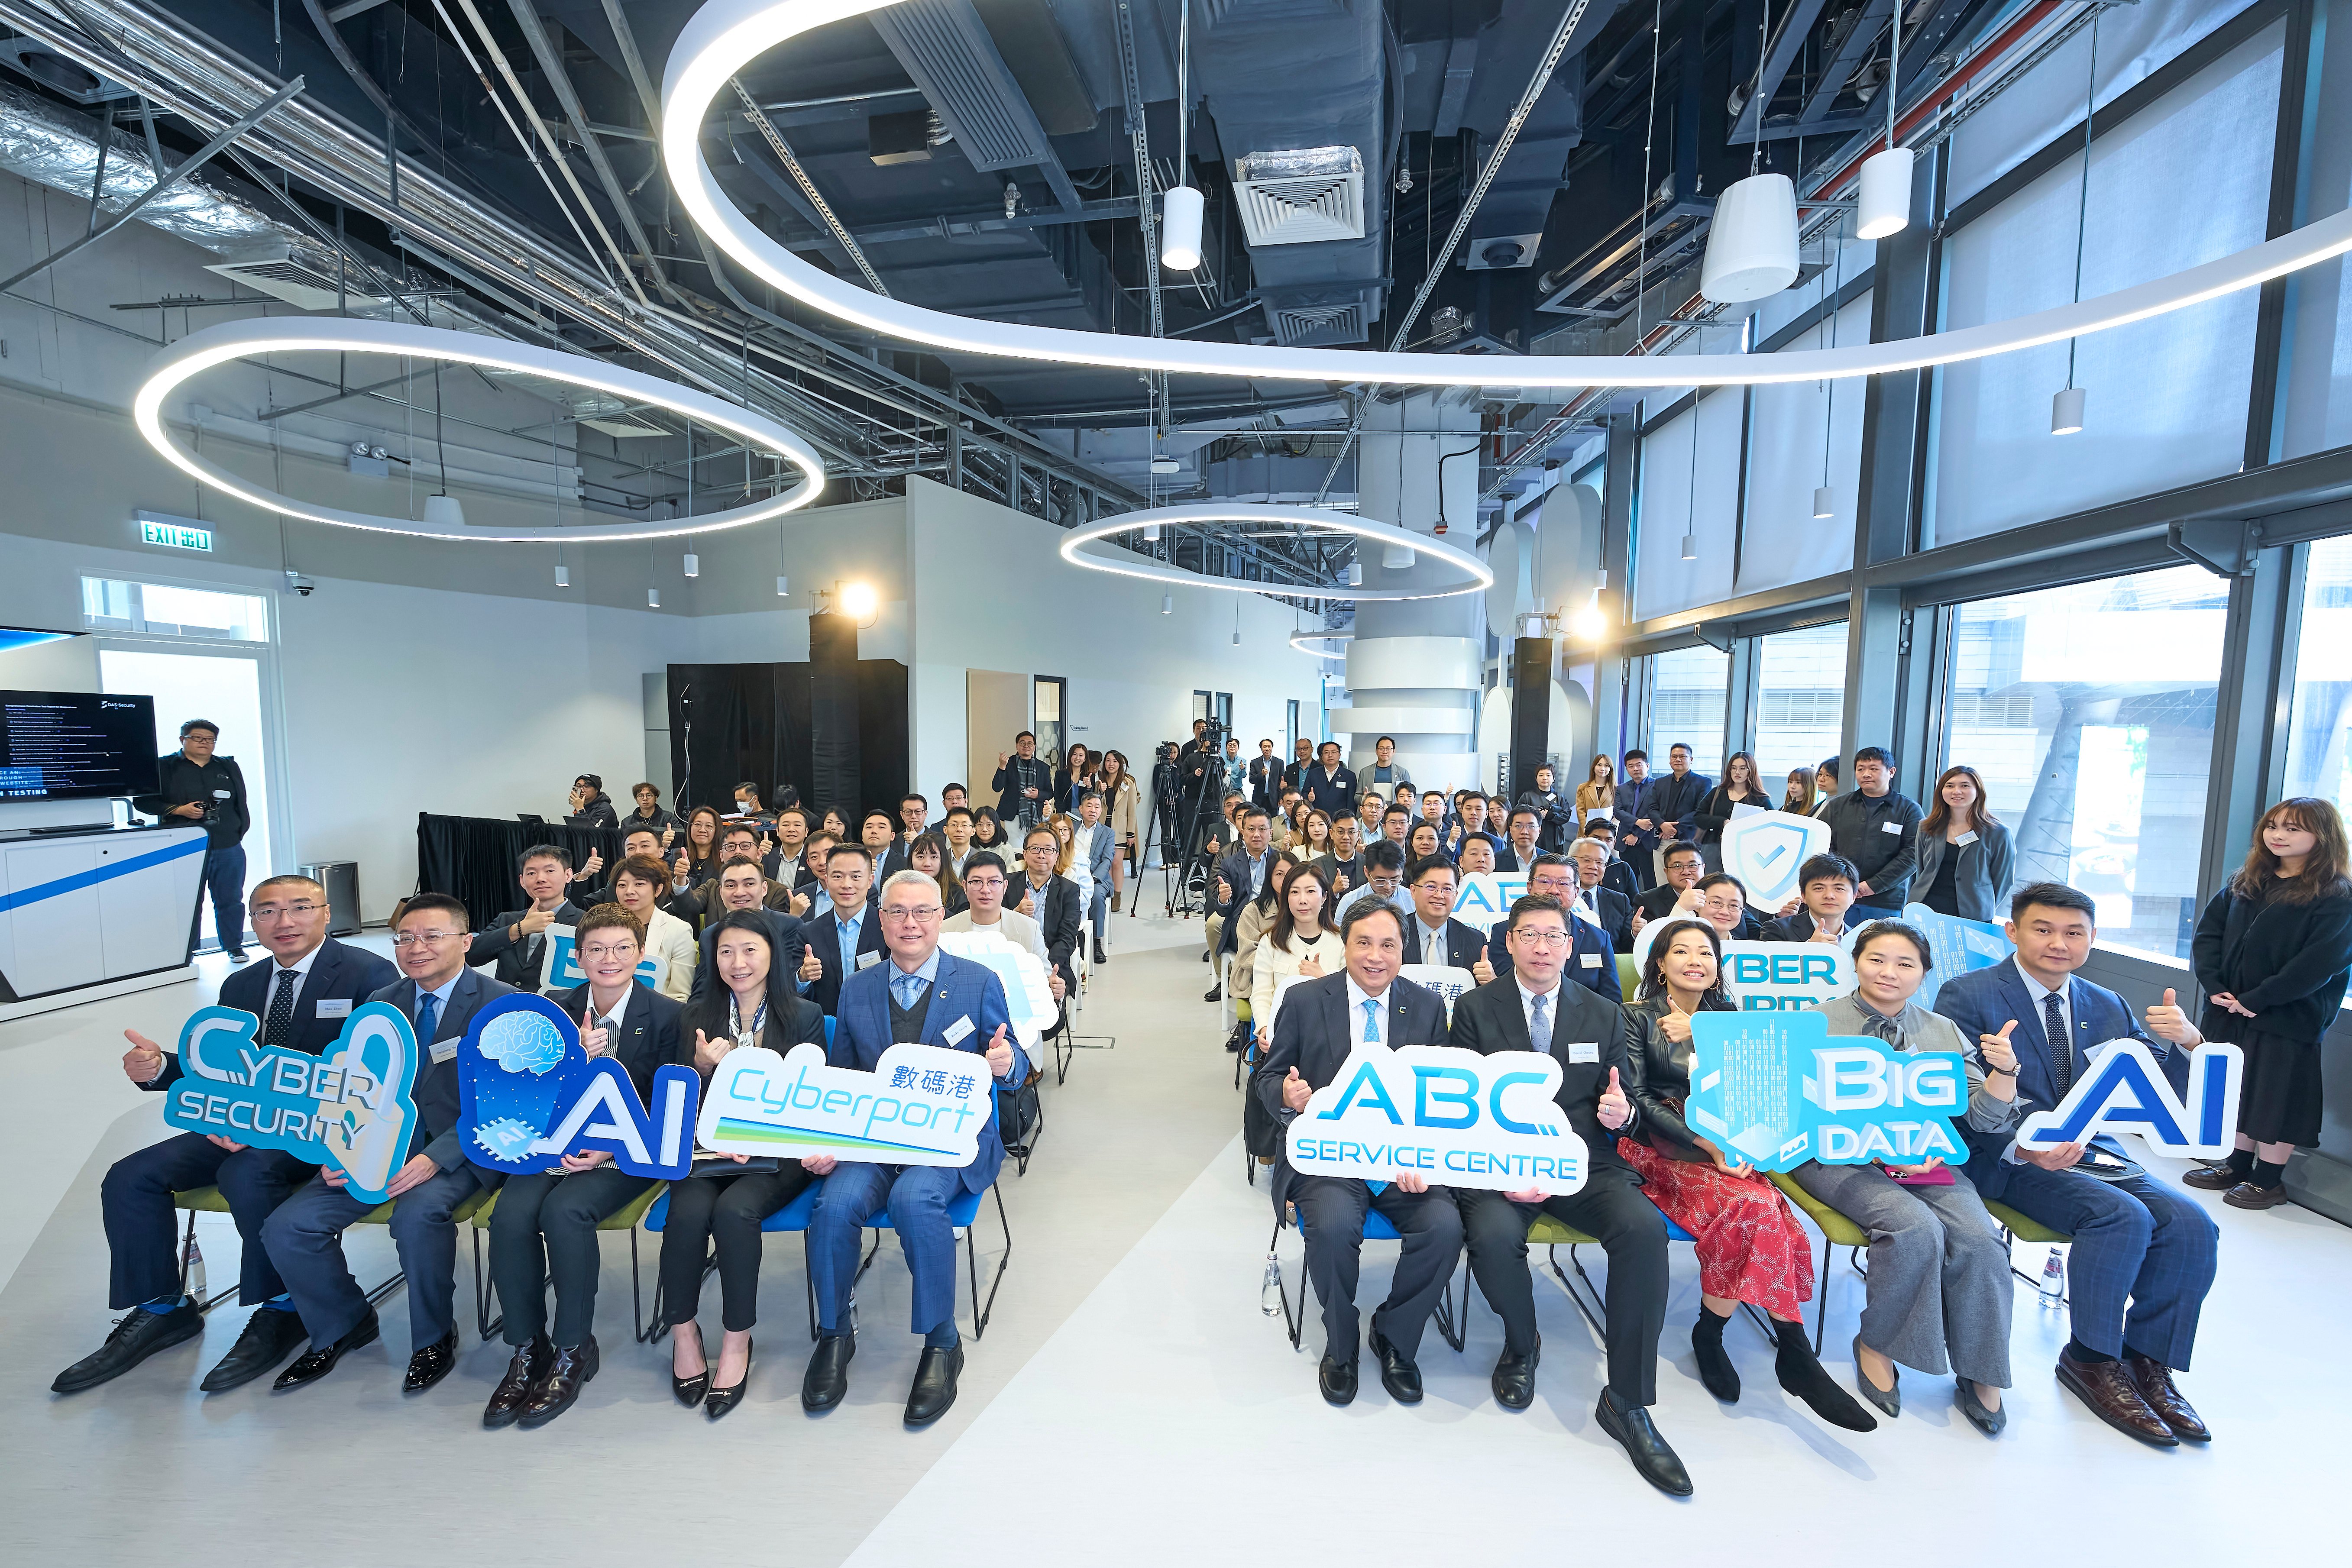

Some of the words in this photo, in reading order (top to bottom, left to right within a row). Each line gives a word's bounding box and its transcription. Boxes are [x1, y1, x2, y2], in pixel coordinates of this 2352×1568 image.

[146, 524, 177, 545] EXIT
[181, 530, 208, 550] 出口
[187, 1017, 382, 1110] CYBER
[889, 1065, 976, 1099] 數碼港
[1812, 1046, 1957, 1115] BIG
[175, 1090, 370, 1150] SECURITY
[529, 1071, 687, 1167] AI
[729, 1065, 975, 1138] Cyberport
[1316, 1061, 1559, 1136] ABC
[2029, 1052, 2228, 1146] AI
[497, 1127, 526, 1147] AI
[1296, 1139, 1435, 1169] SERVICE
[1444, 1150, 1578, 1180] CENTRE
[1818, 1122, 1956, 1161] DATA
